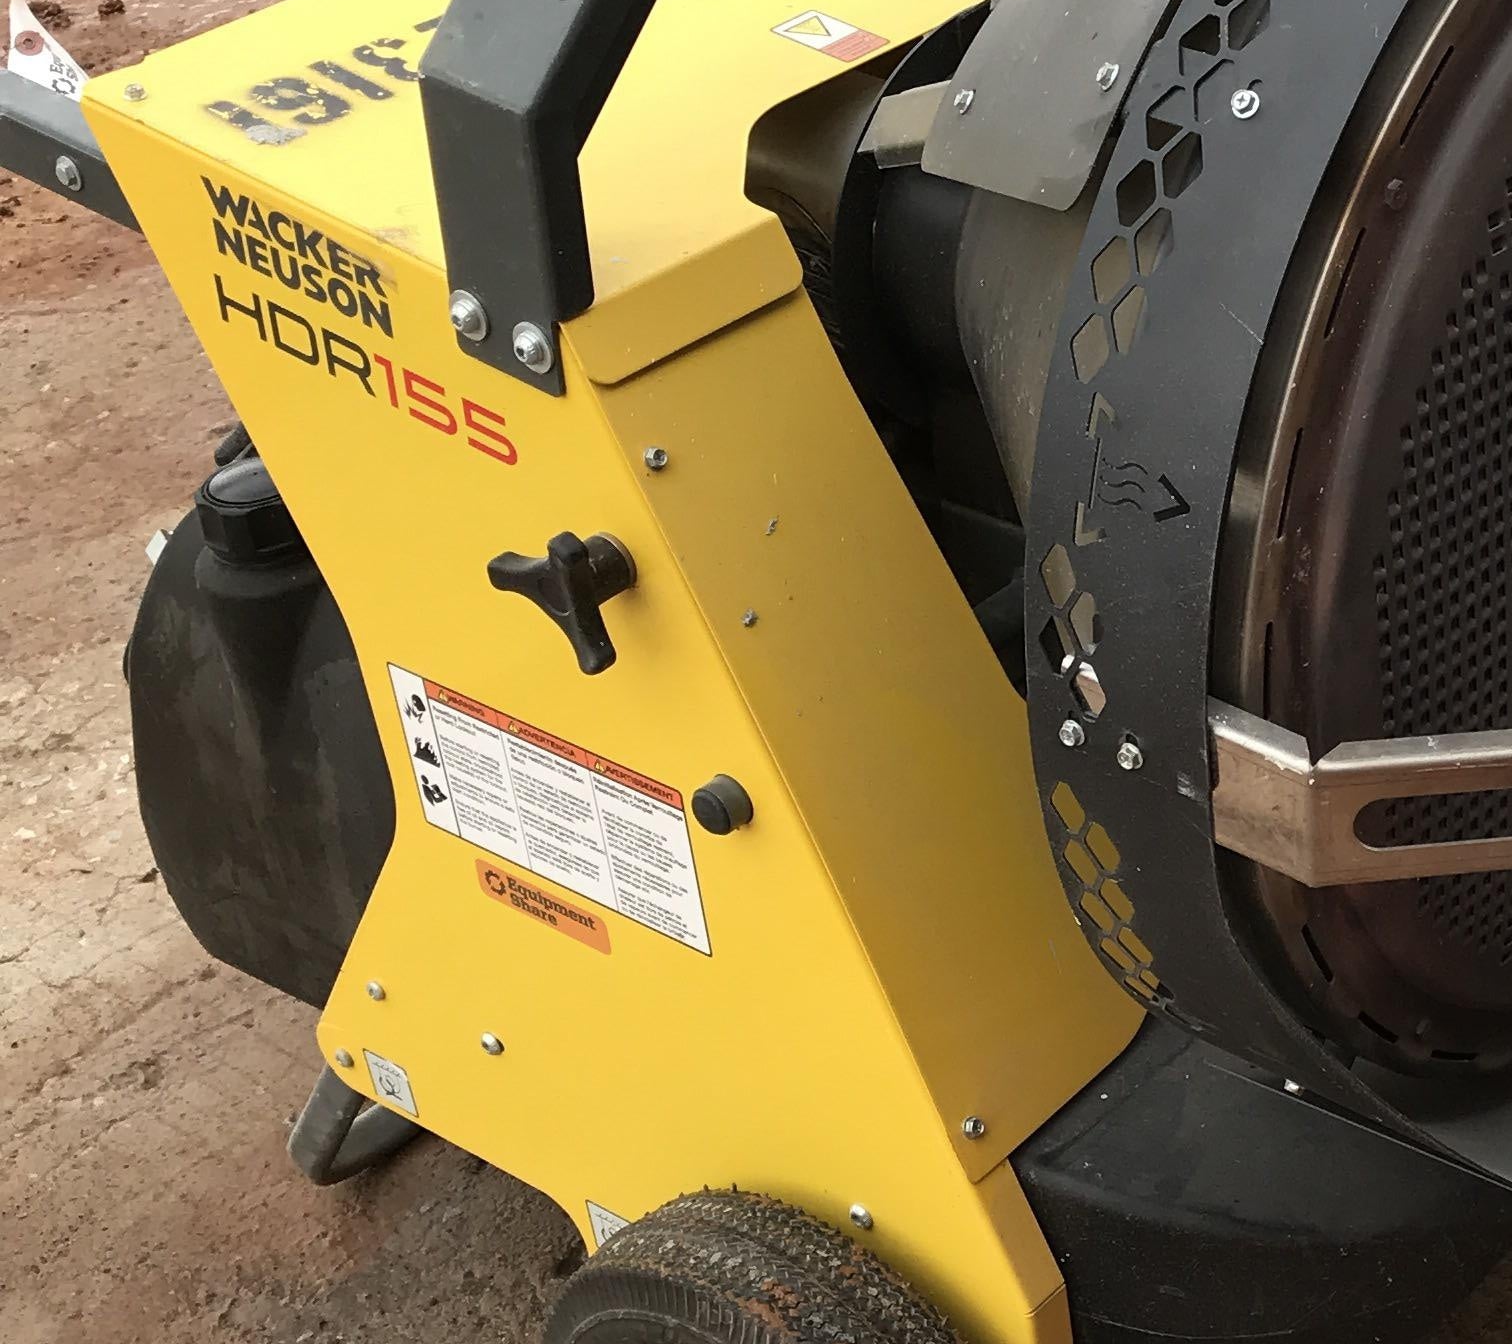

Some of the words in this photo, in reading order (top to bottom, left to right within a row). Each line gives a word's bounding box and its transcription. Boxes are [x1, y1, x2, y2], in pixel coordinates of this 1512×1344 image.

[200, 174, 388, 299] WACKER
[212, 217, 394, 340] NEUSON
[213, 273, 518, 466] HDR155
[506, 875, 597, 931] Equipment
[509, 892, 558, 926] Share
